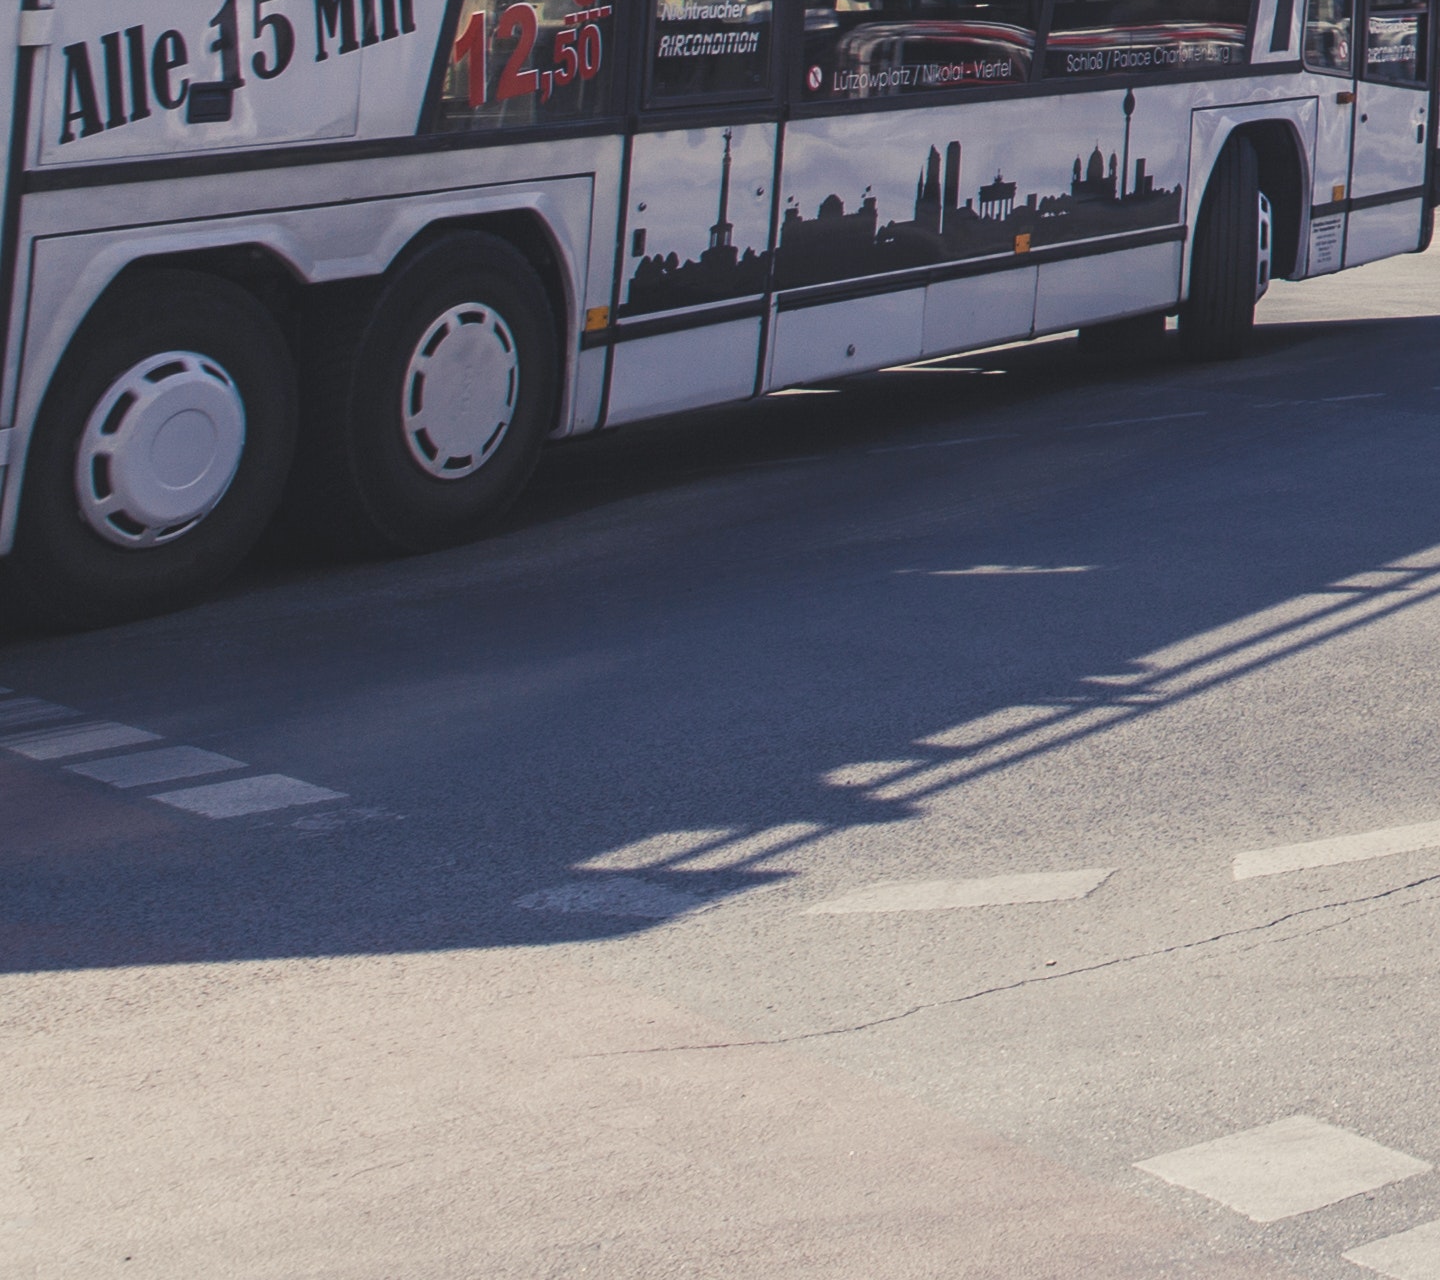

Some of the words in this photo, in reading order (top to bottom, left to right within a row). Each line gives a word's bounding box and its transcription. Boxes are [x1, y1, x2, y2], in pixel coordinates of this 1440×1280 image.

[661, 1, 746, 21] Nichtraucher
[454, 2, 601, 109] 12,50
[658, 31, 760, 57] AIRCONDITION
[1113, 50, 1151, 68] Palace
[59, 22, 189, 145] Alle
[833, 66, 910, 91] Lützowplatz
